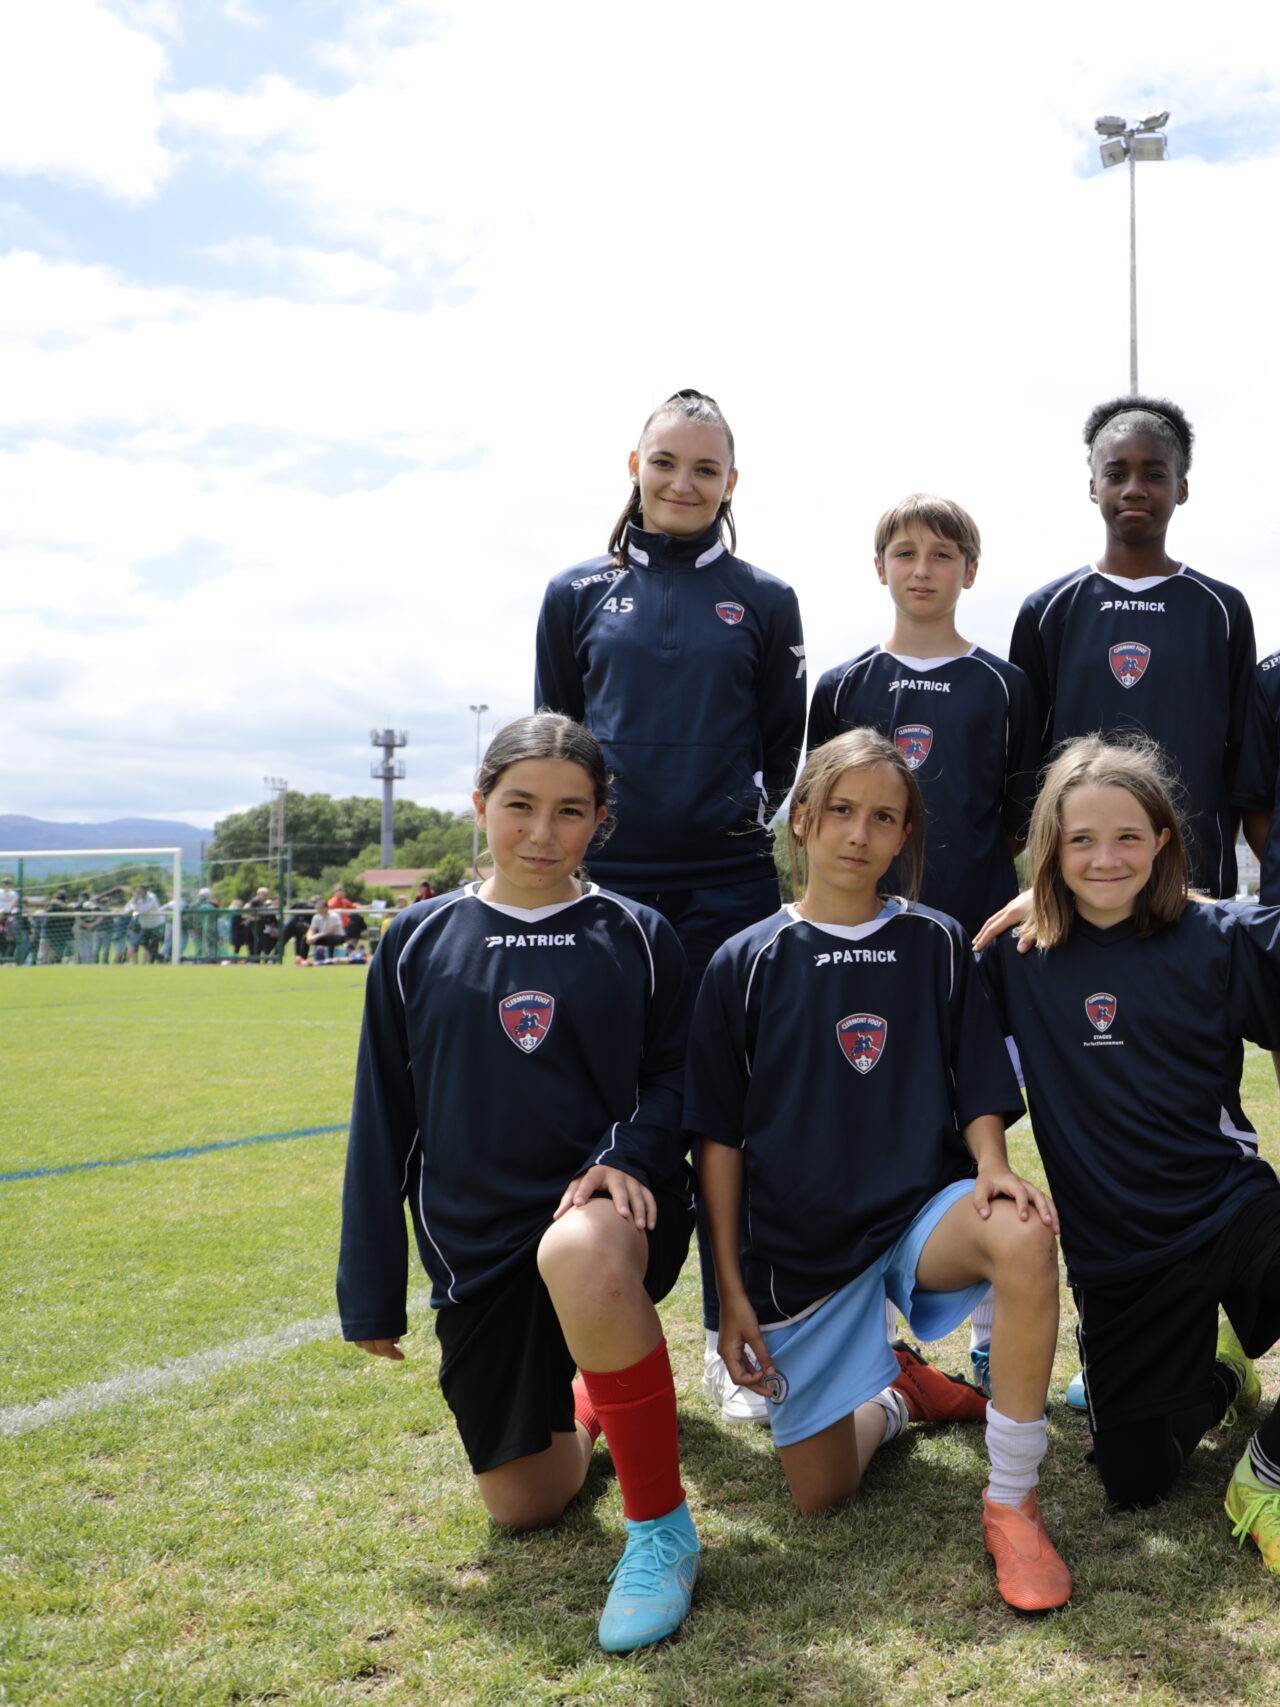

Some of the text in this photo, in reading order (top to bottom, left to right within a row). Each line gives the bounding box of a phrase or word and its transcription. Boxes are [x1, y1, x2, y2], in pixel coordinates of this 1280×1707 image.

[603, 597, 634, 613] 45
[1114, 600, 1166, 612] PATRICK
[900, 679, 951, 693] PATRICK
[505, 933, 576, 947] PATRICK
[832, 949, 897, 964] PATRICK
[522, 1039, 534, 1047] 63
